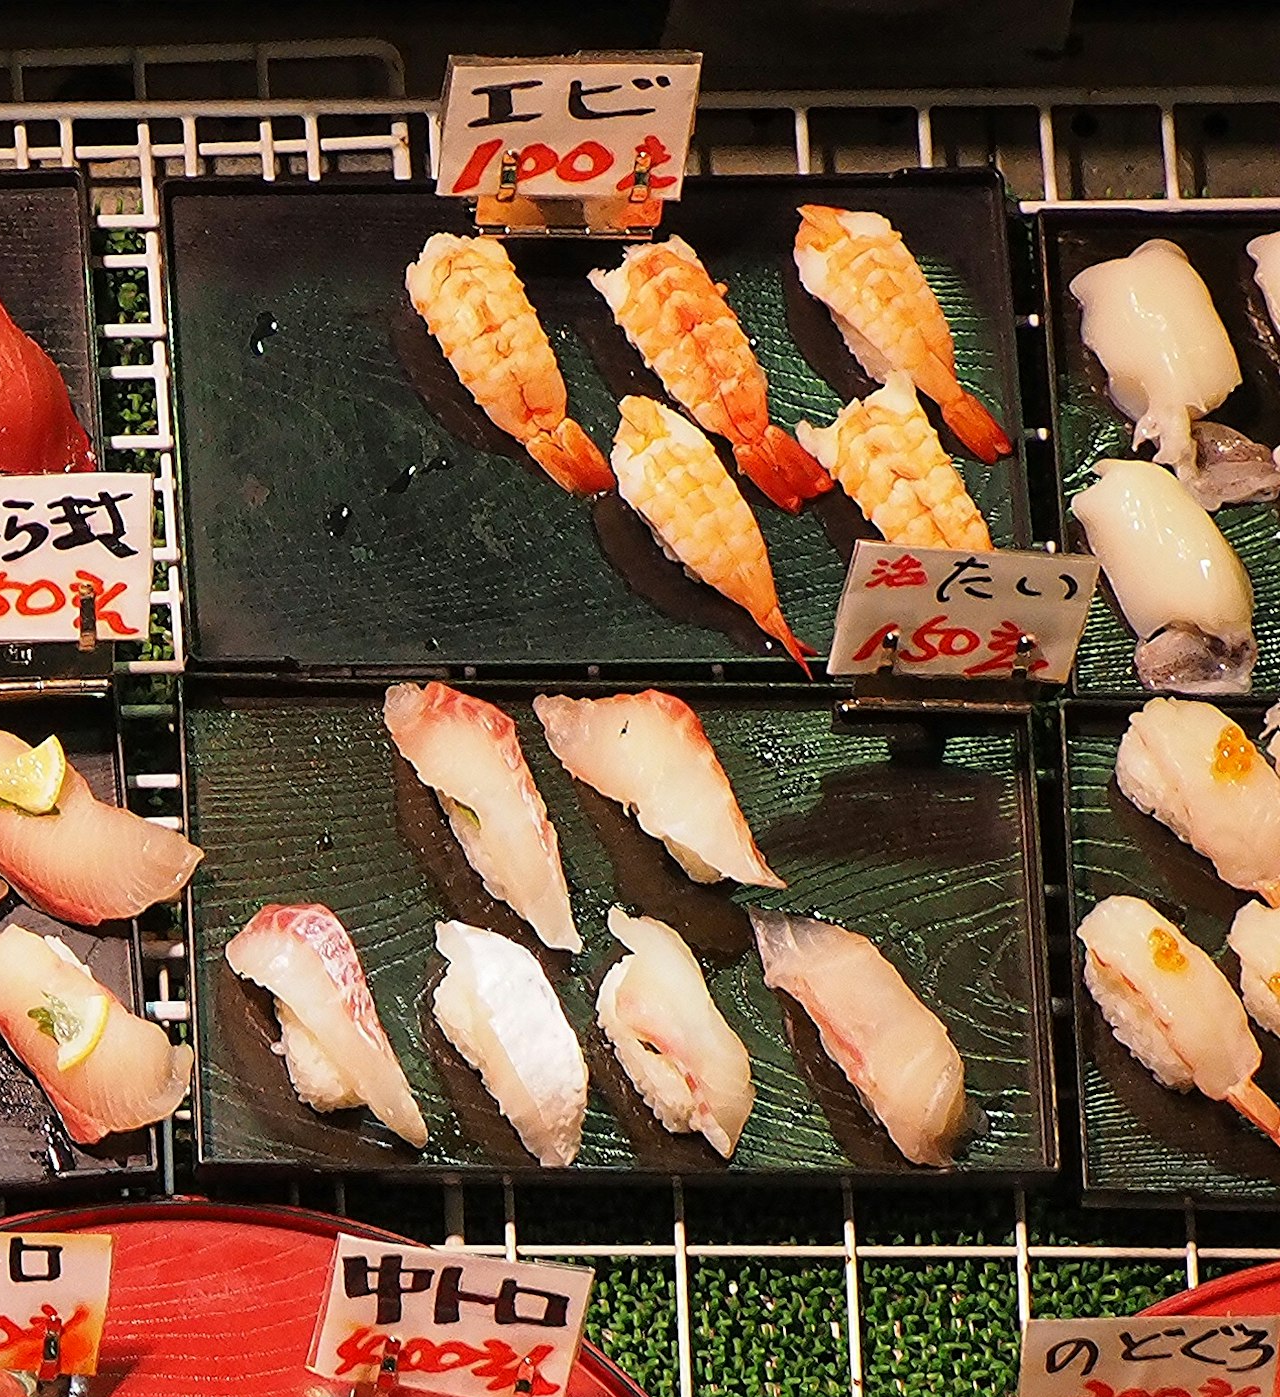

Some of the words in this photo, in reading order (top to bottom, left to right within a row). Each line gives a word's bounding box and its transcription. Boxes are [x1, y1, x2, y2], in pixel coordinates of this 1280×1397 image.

[467, 75, 672, 128] エビ
[341, 1254, 571, 1327] 中トロ
[1044, 1323, 1276, 1376] のどぐろ
